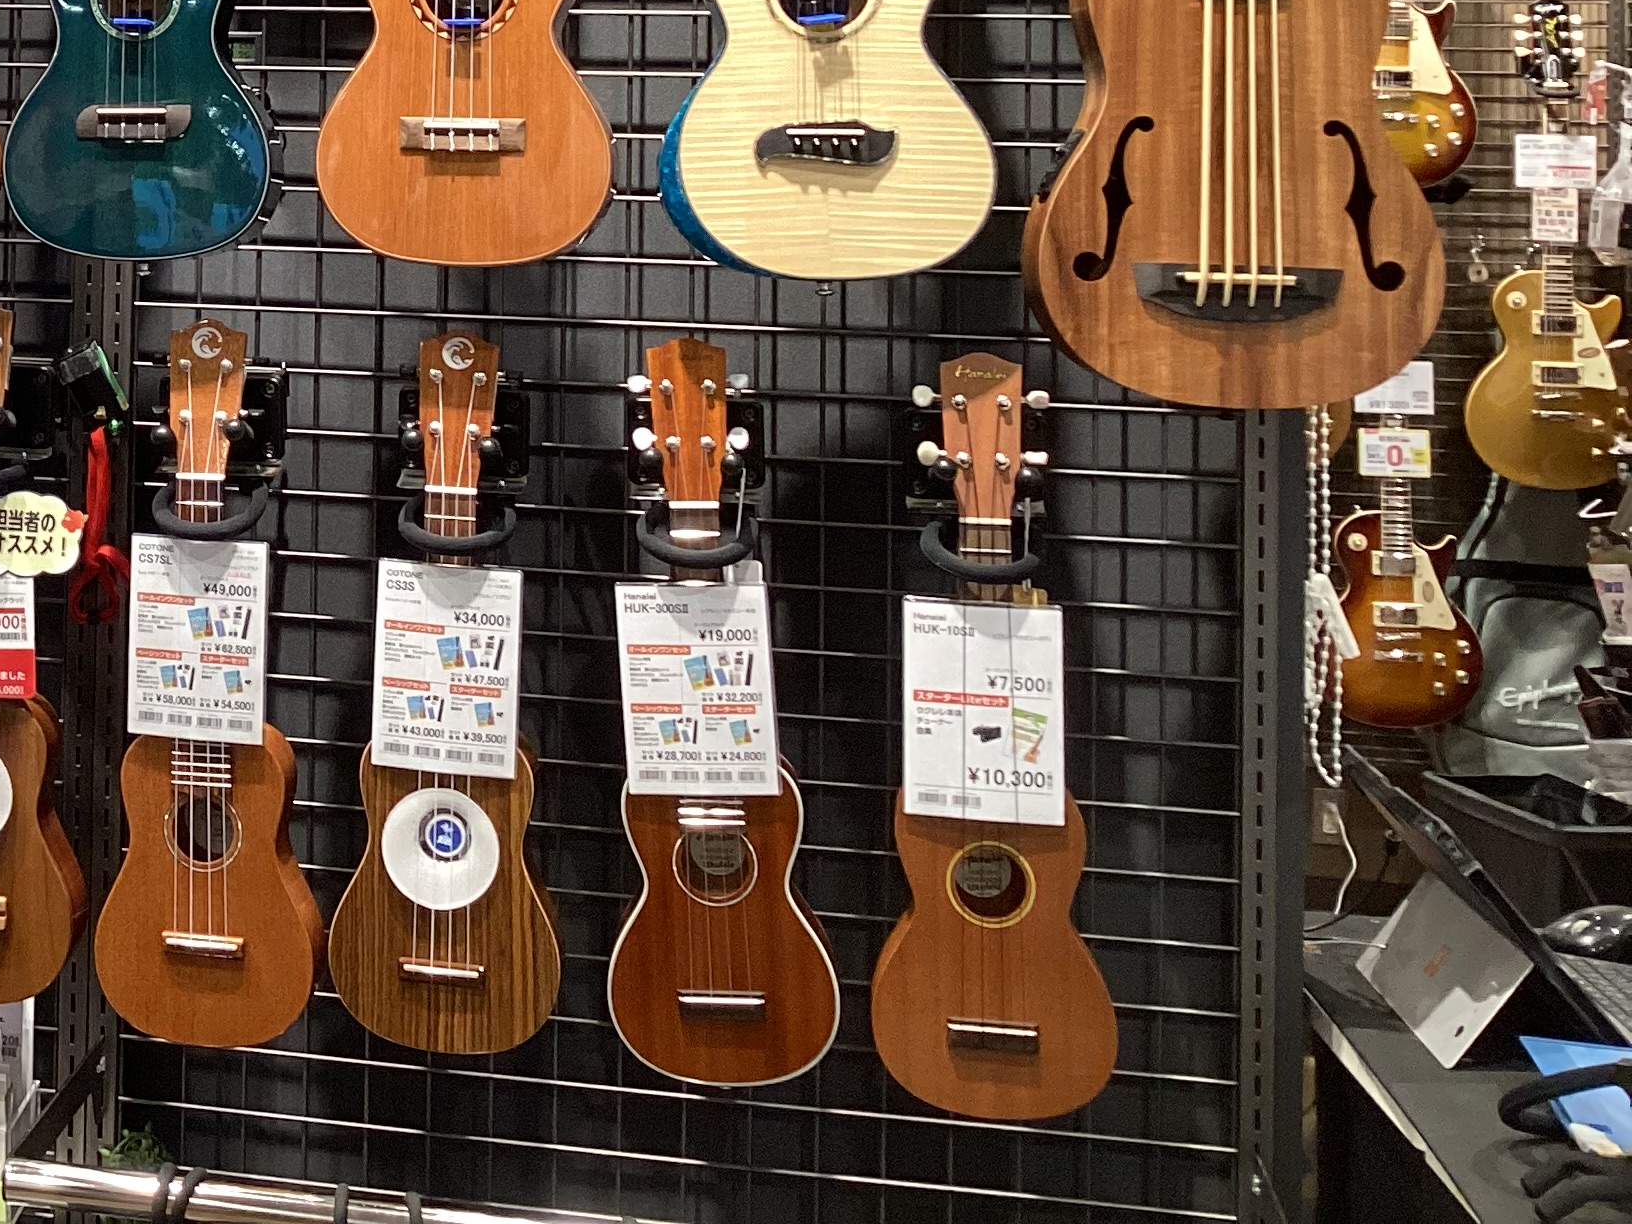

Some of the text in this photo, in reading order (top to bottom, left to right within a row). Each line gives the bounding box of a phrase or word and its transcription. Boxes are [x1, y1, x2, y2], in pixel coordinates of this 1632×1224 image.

[1386, 444, 1404, 467] 0
[138, 543, 175, 553] COTONE
[138, 553, 173, 565] CS7SL
[386, 568, 424, 580] COTONE
[203, 582, 252, 597] ¥49,000
[386, 580, 416, 592] CS3S
[624, 592, 657, 601] Hanalei
[454, 611, 505, 627] ¥34,000
[698, 628, 752, 642] ¥19,000
[215, 643, 252, 656] ¥62,500
[465, 673, 505, 686] ¥47,500
[987, 674, 1046, 693] ¥7,500
[156, 693, 192, 707] ¥58,000
[717, 692, 758, 703] ¥32,200
[214, 699, 252, 711] ¥54,500
[402, 725, 441, 738] ¥43,000
[463, 732, 503, 745] ¥39,500
[657, 750, 697, 761] ¥28,700
[968, 766, 1046, 788] ¥10,300
